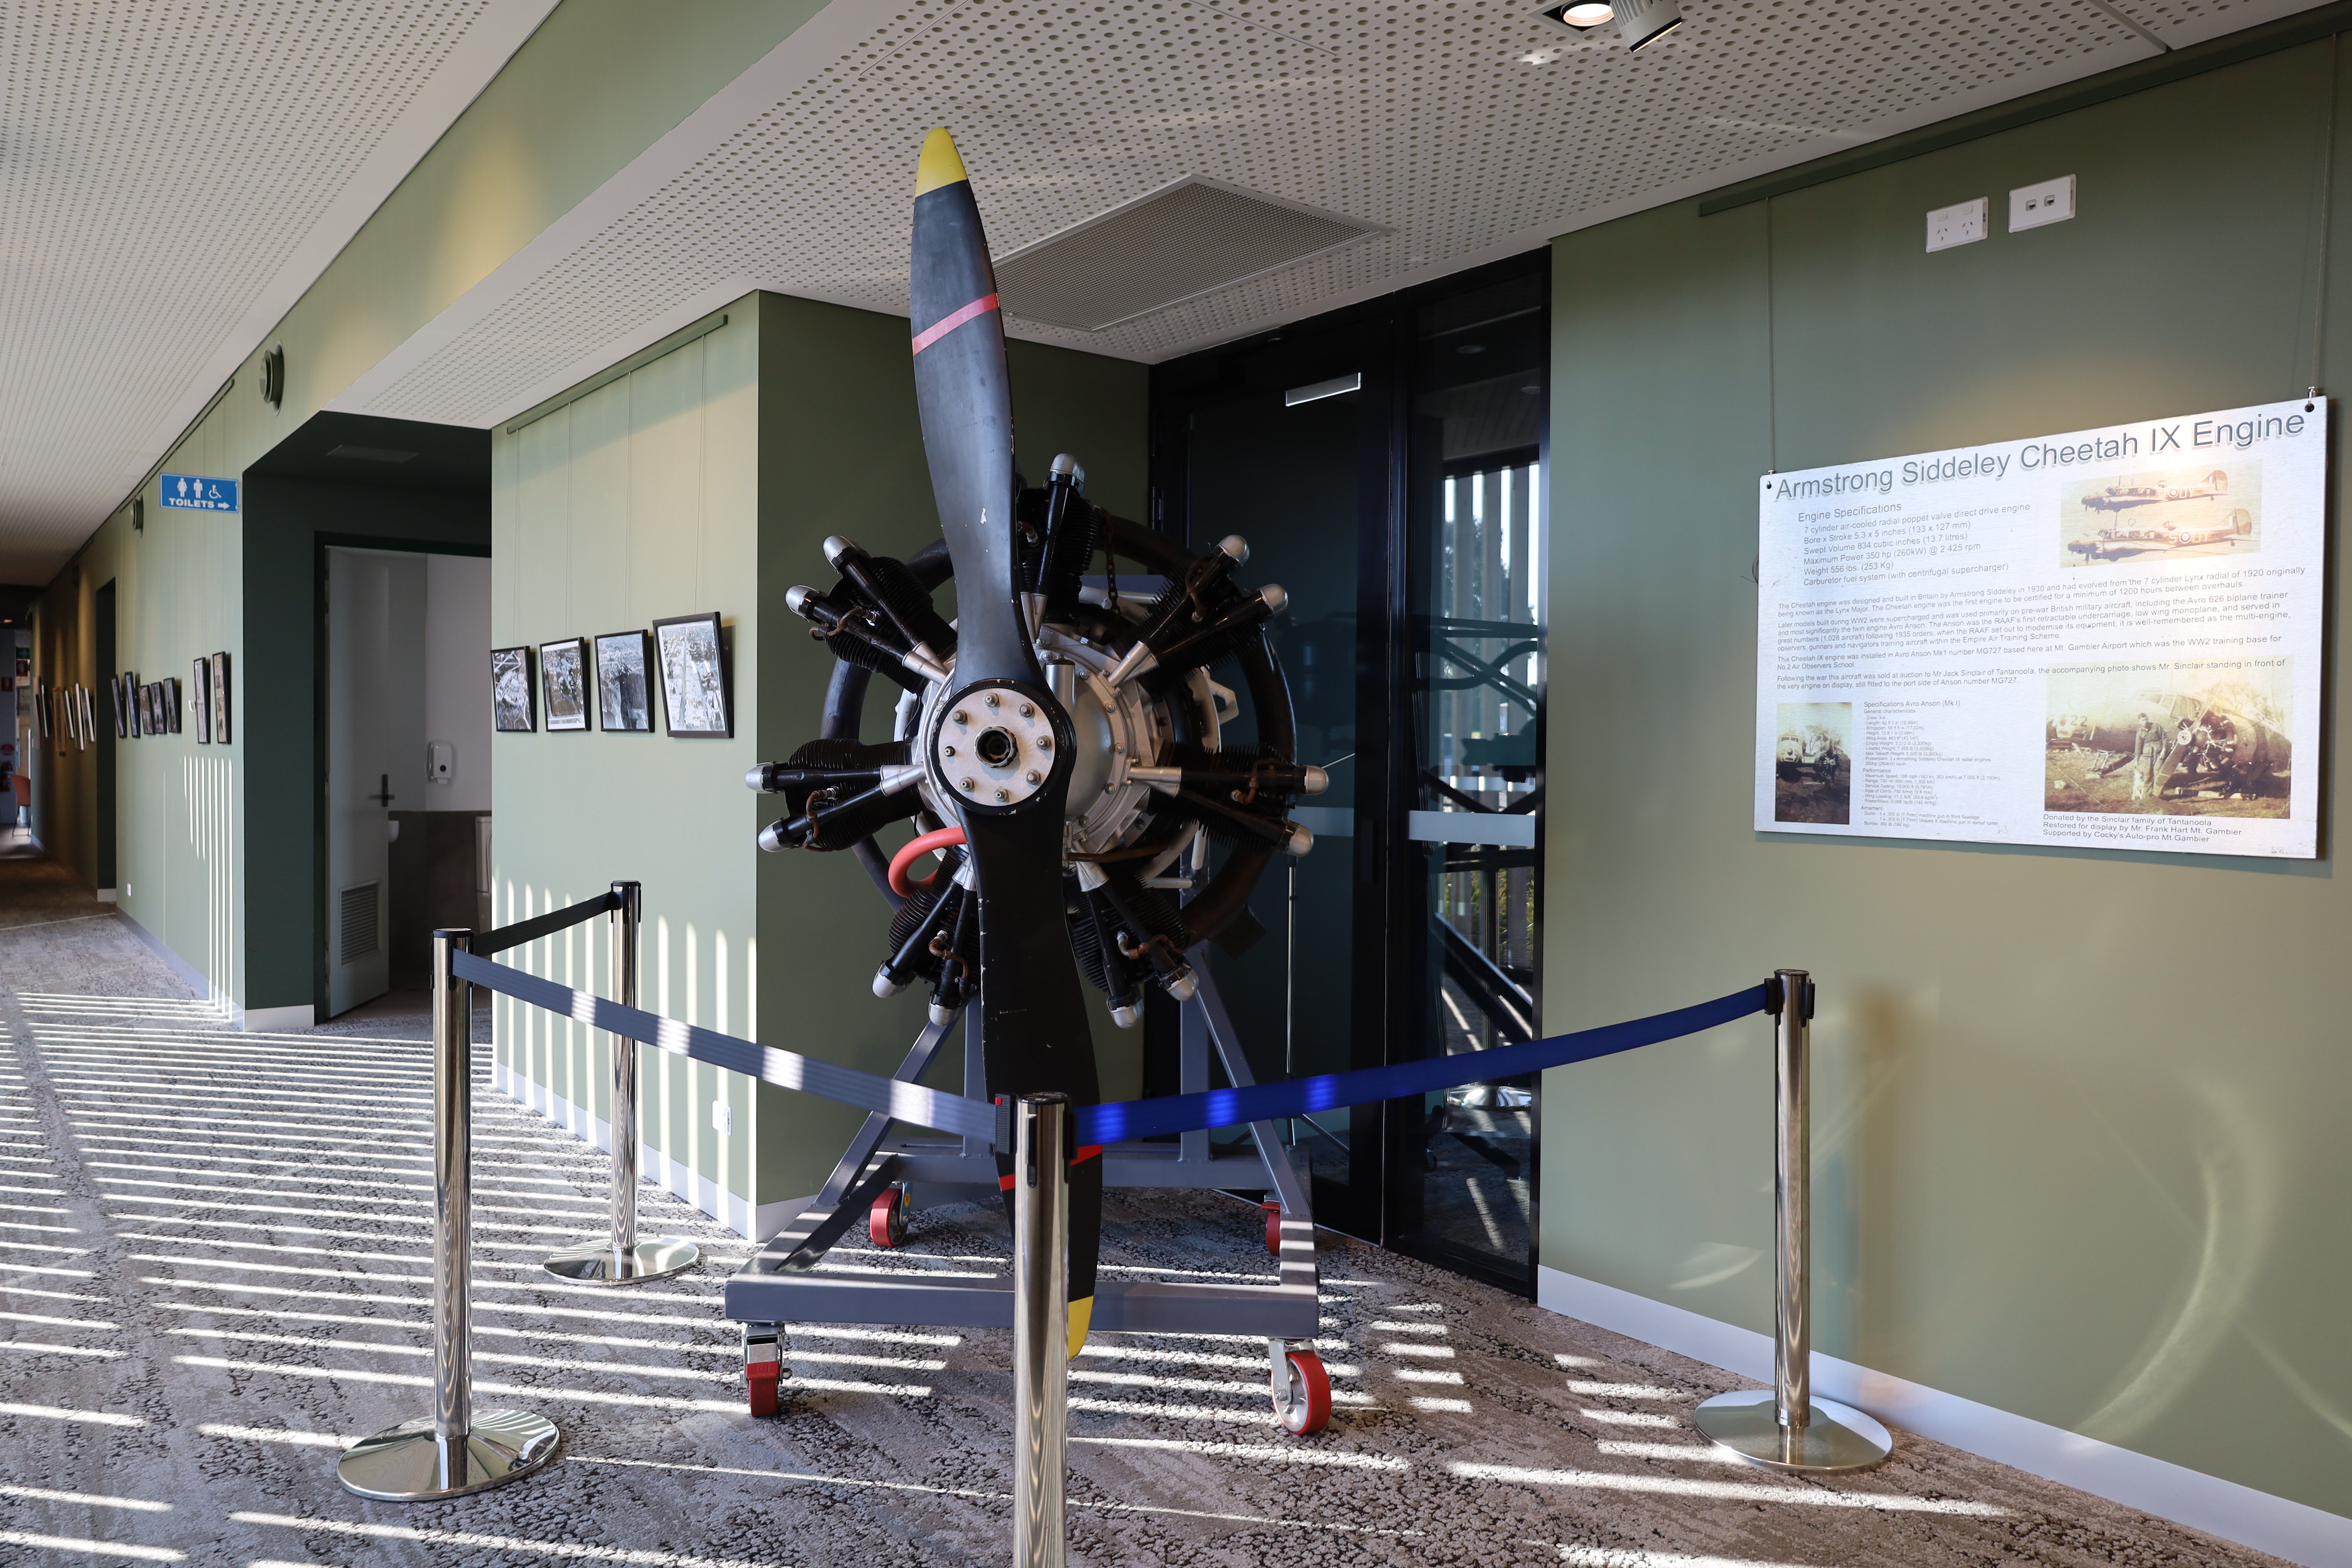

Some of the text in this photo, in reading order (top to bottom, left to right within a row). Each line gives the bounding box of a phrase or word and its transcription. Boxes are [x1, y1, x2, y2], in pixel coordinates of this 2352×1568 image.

[1776, 413, 2305, 499] Armstrong Siddeley Cheetah IX Engine
[168, 498, 214, 508] TOILETS
[1798, 504, 1902, 523] Engine Specifications
[1810, 524, 1839, 534] cylinder
[1840, 519, 1877, 530] air-cooled
[1879, 517, 1900, 526] radial
[1902, 514, 1929, 525] poppet
[1931, 512, 1952, 520] valve
[1954, 508, 1977, 518] direct
[1978, 507, 1999, 515] drive
[2001, 504, 2030, 513] engine
[1829, 533, 1852, 542] Stroke
[1854, 531, 1866, 539] 5.3
[1882, 528, 1906, 536] inches
[1908, 525, 1926, 535] (133
[1936, 522, 1950, 531] 127
[1952, 520, 1971, 530] mm)
[1804, 546, 1826, 555] Swept
[1857, 541, 1871, 550] 834
[1896, 537, 1920, 546] inches
[1923, 534, 1943, 545] (13.7
[1945, 532, 1968, 541] litres)
[1804, 557, 1838, 565] Maximum
[1882, 551, 1891, 559] hp
[1894, 547, 1926, 559] (260kW)
[1929, 546, 1938, 556] @
[1940, 544, 1963, 553] 2,425
[1965, 544, 1981, 552] rpm
[1803, 577, 1842, 586] Carburetor
[1859, 574, 1886, 583] system
[1888, 571, 1906, 581] (with
[1908, 567, 1949, 577] centrifugal
[1951, 562, 2009, 575] supercharger)
[1804, 567, 1829, 576] Weight
[1861, 562, 1878, 572] (253
[1880, 561, 1894, 570] Kg)
[2052, 665, 2105, 674] accompanying
[2107, 665, 2129, 673] photo
[2206, 661, 2242, 669] standing
[2094, 831, 2124, 839] Cocky's
[2125, 833, 2159, 841] Auto-pro
[2161, 834, 2210, 842] Mt.Gambier
